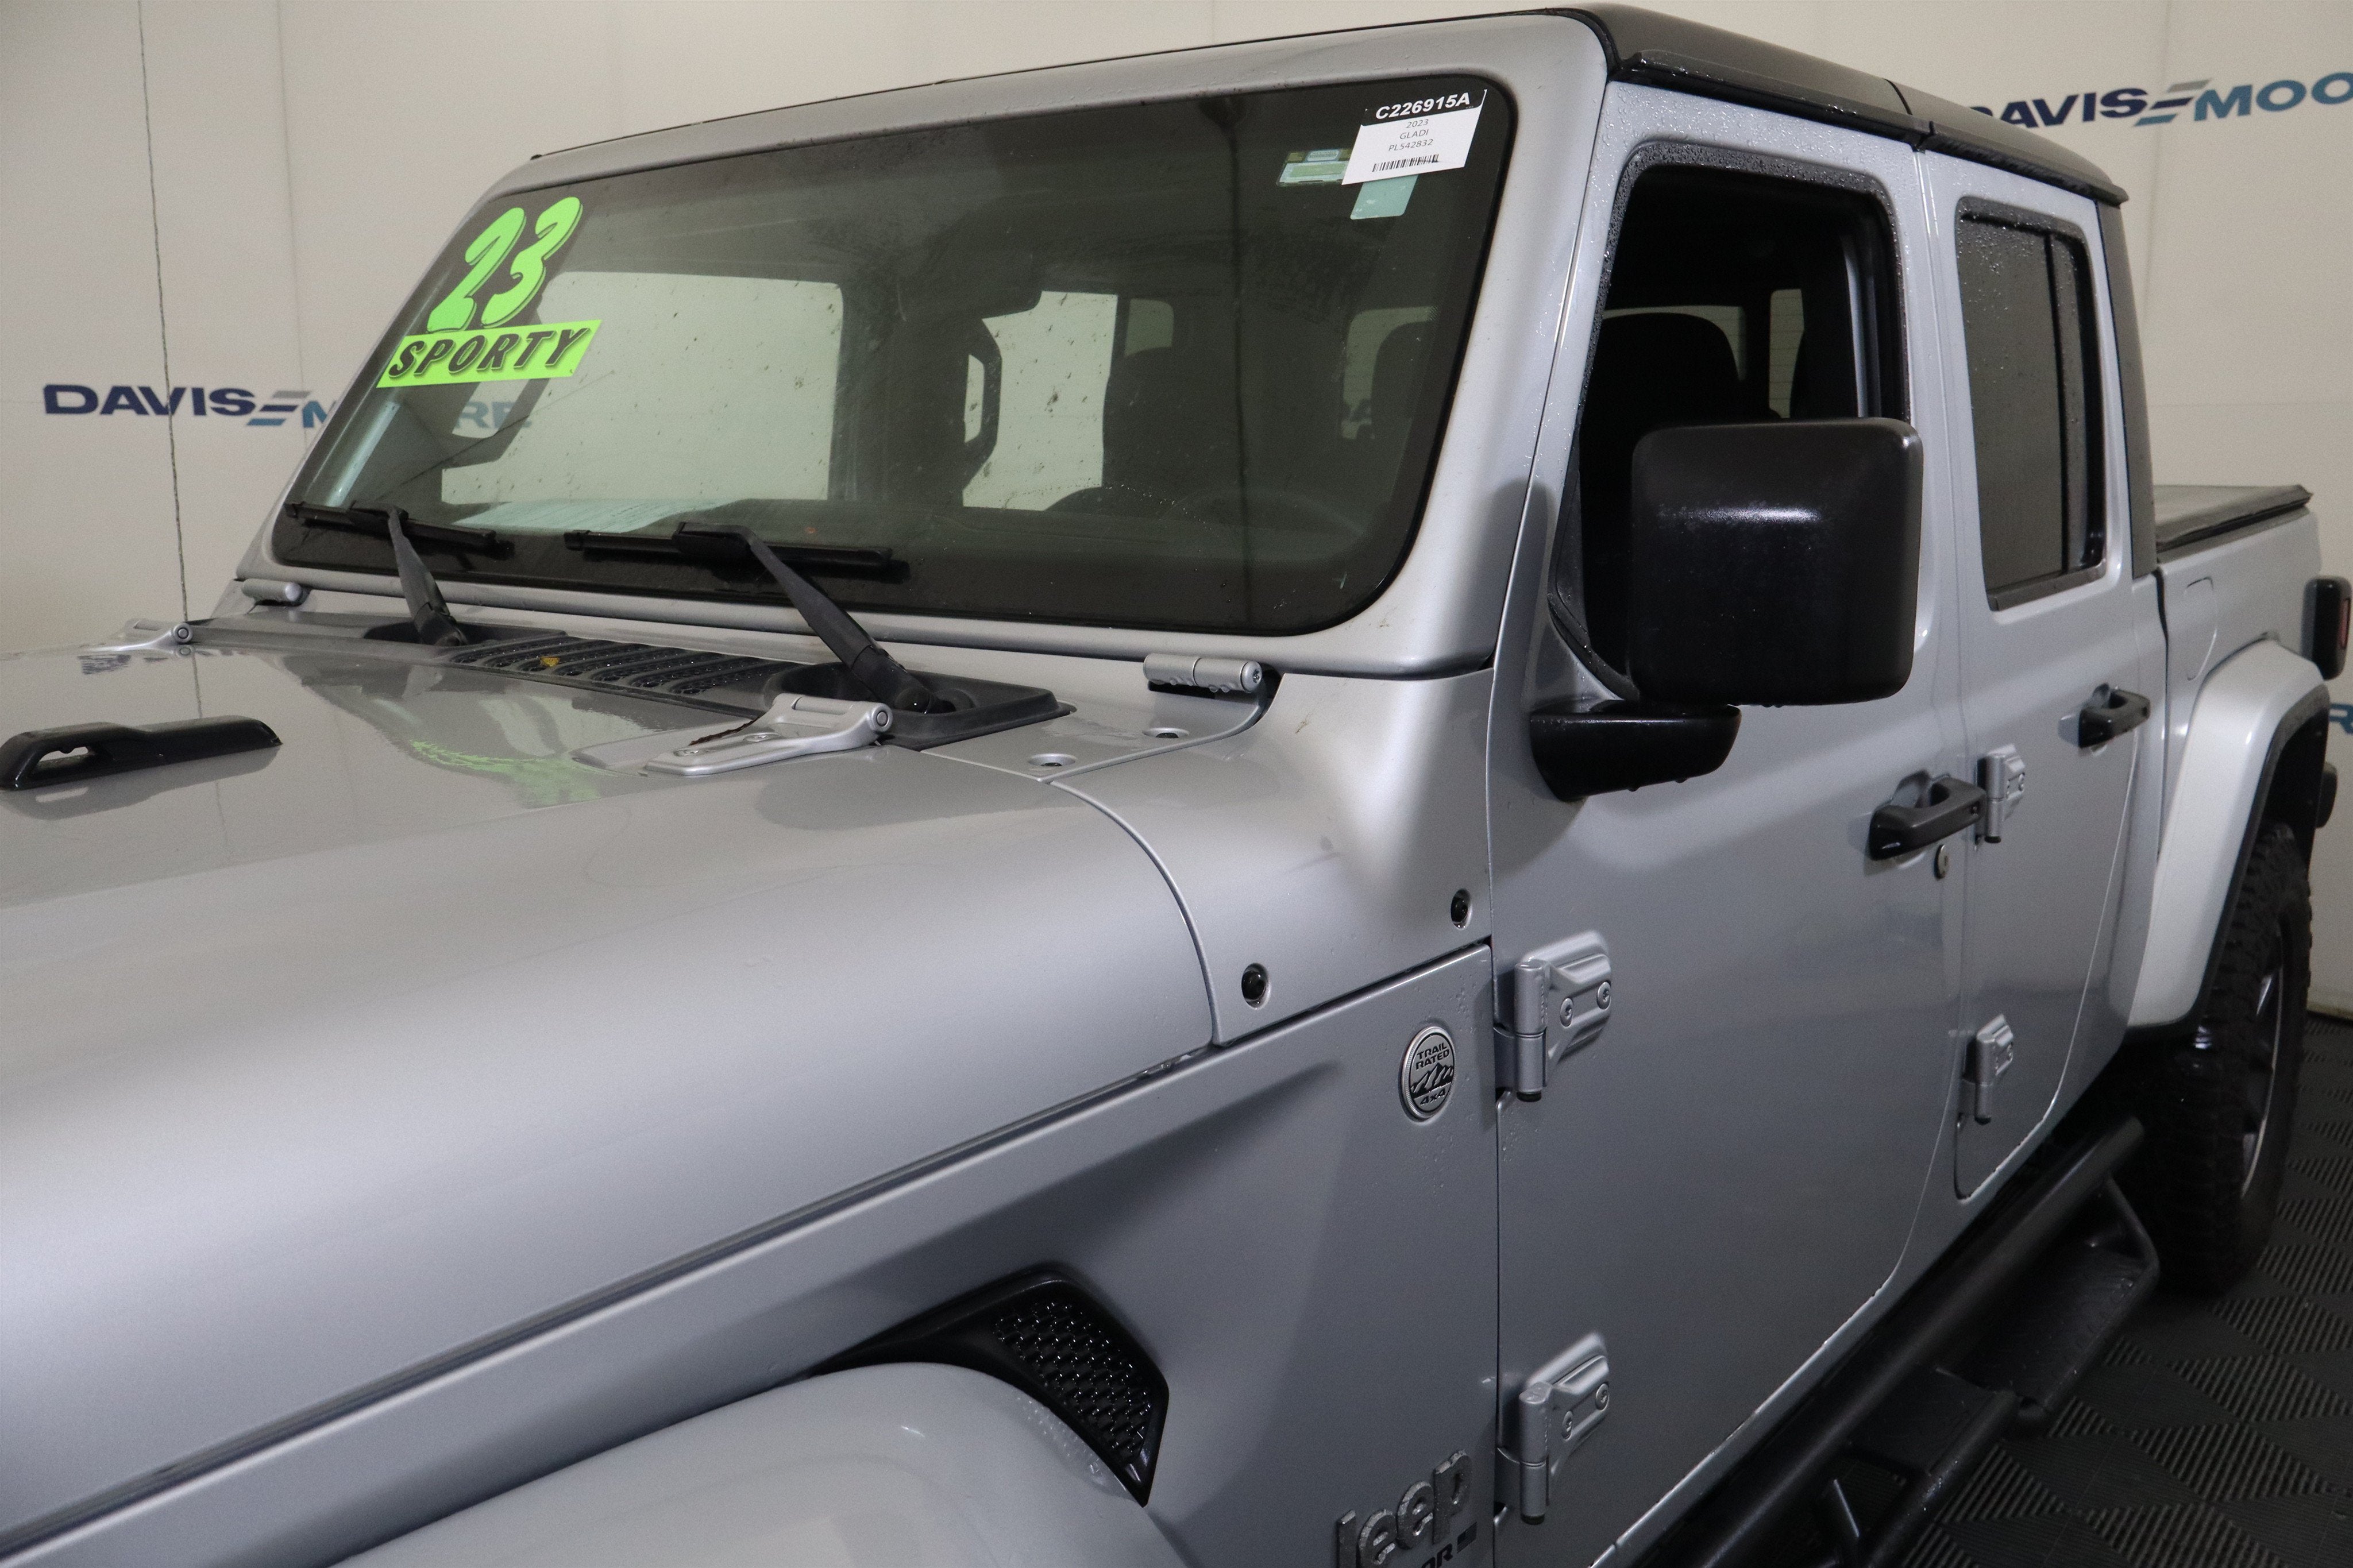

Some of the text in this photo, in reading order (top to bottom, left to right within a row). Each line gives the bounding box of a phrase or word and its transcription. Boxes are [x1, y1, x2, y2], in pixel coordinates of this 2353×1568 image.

[1375, 92, 1470, 119] C226915A
[1970, 88, 2147, 128] AVIS
[1400, 129, 1429, 139] GLADI
[1406, 118, 1429, 128] 2023
[1388, 139, 1433, 151] PL542832
[426, 196, 583, 333] 23
[388, 327, 592, 379] SPORTY
[43, 384, 256, 416] DAVIS
[1415, 1049, 1450, 1070] RATED
[1417, 1042, 1448, 1060] TRAIL
